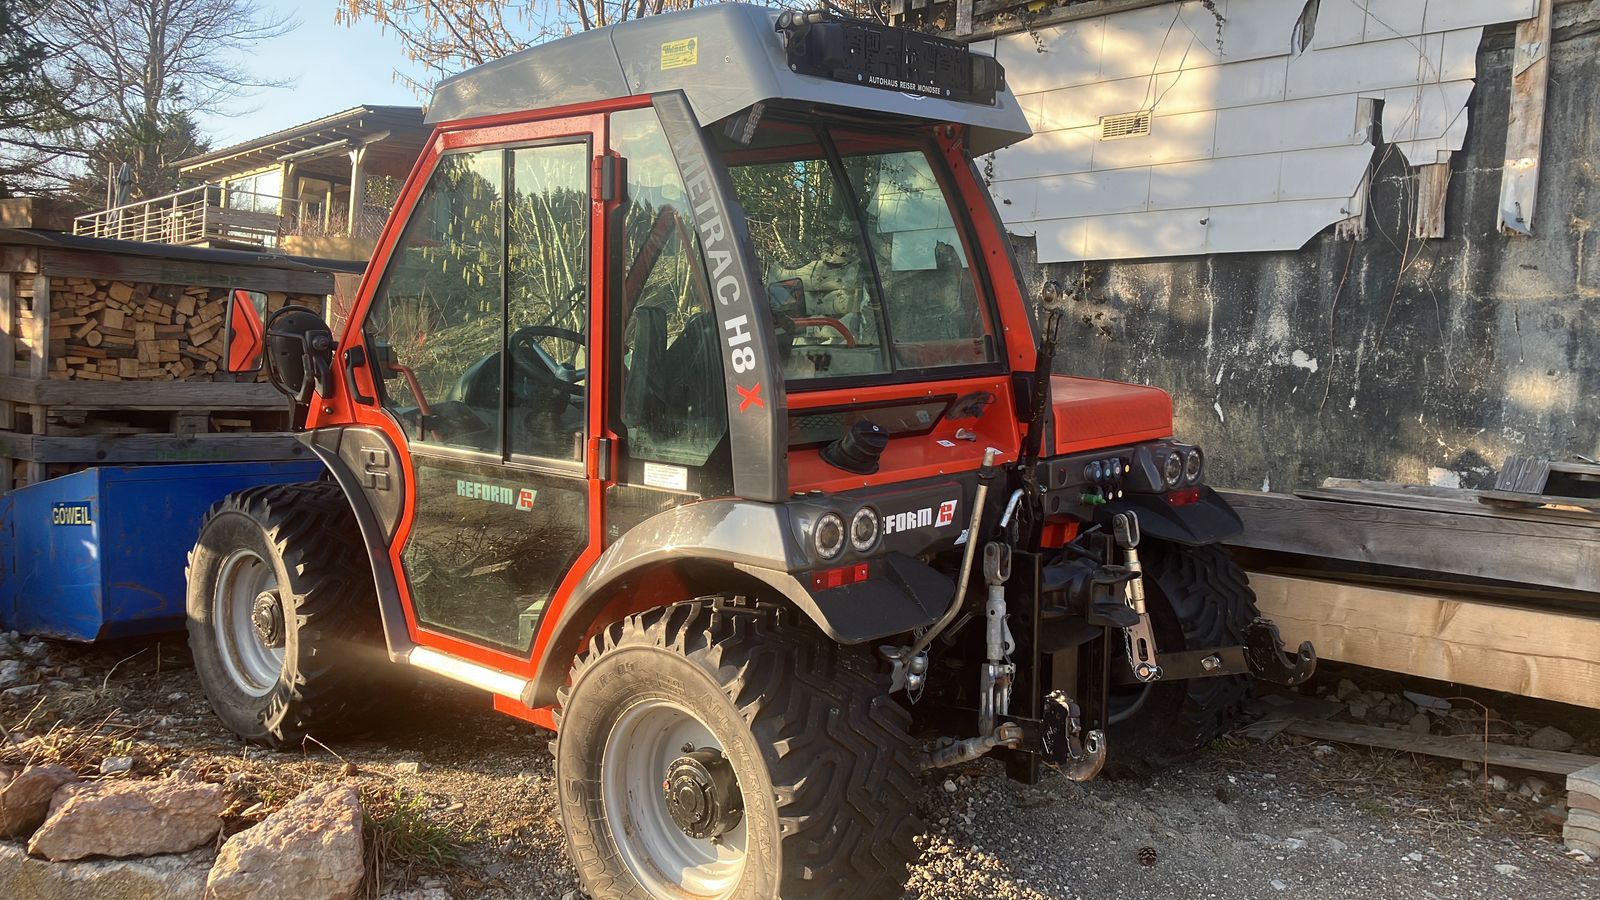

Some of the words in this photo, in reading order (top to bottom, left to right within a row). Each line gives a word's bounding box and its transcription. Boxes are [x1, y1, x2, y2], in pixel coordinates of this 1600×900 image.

[869, 76, 898, 87] AUTOHAUS
[900, 81, 916, 91] REISER
[918, 84, 940, 95] MONDSEE
[674, 136, 741, 306] METRAC
[725, 314, 756, 374] H8
[736, 382, 764, 414] X
[457, 480, 513, 505] REFORM
[53, 503, 91, 525] GÖWEIL
[883, 508, 932, 535] FORM
